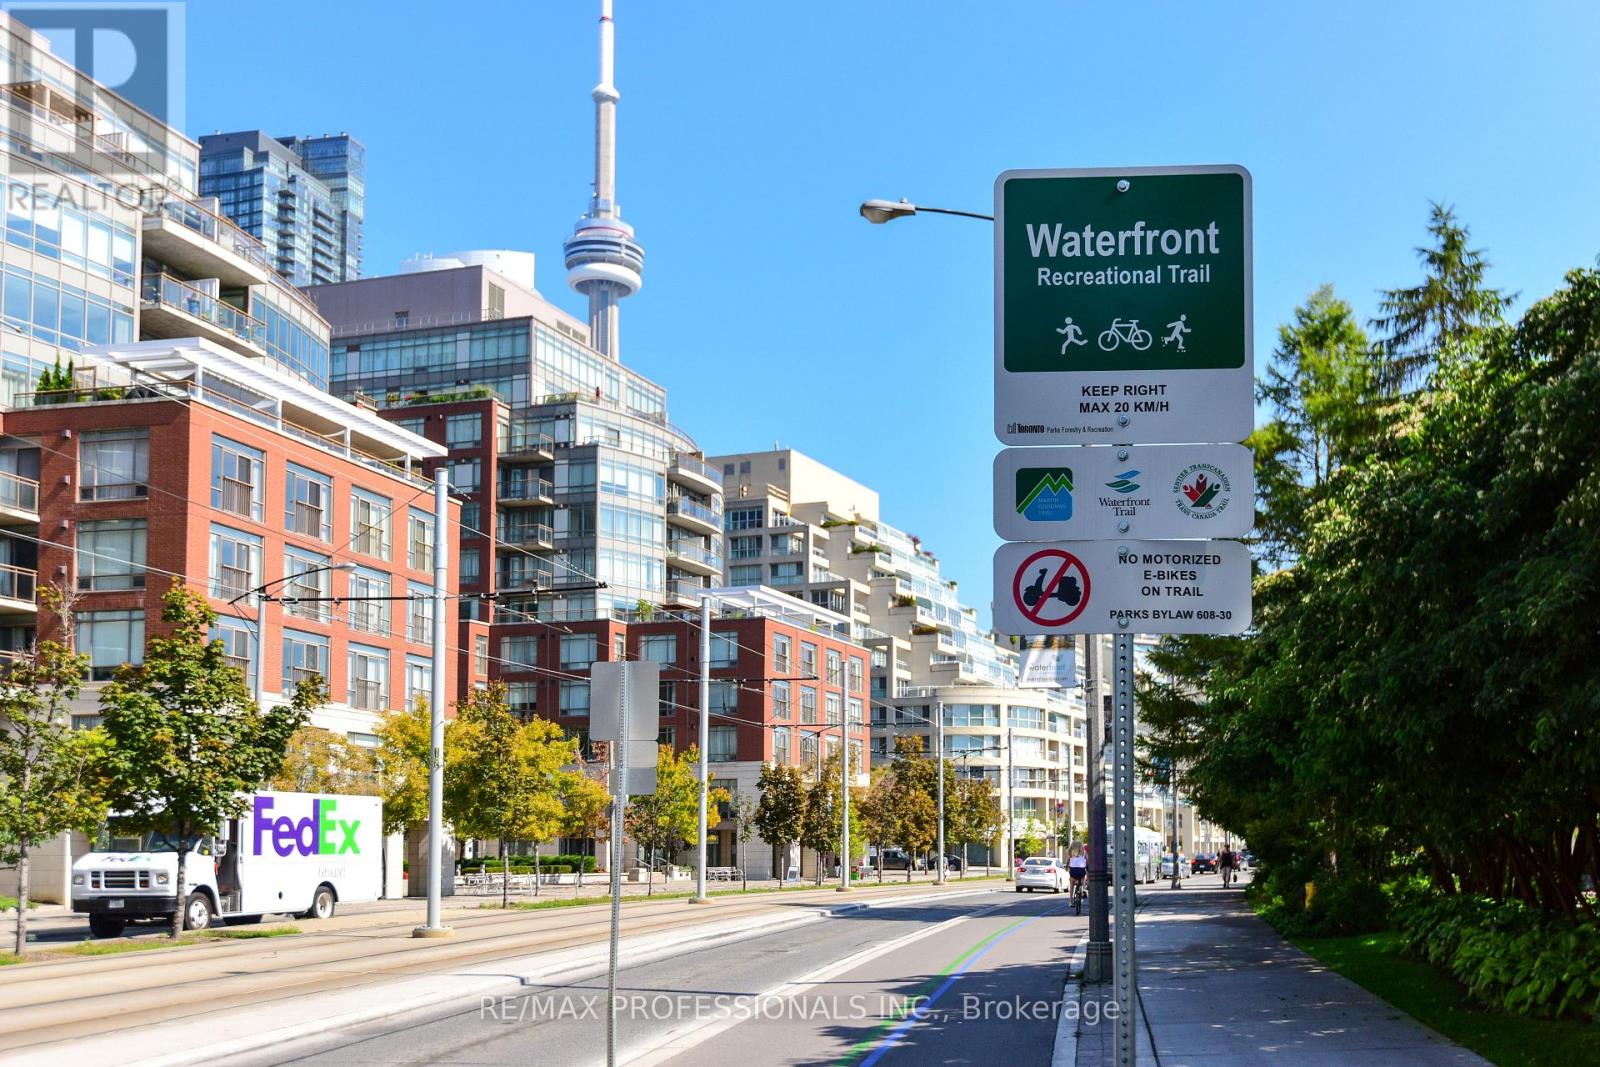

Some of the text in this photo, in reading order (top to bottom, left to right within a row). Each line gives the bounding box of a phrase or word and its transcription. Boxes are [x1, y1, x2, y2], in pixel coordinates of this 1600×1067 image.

[1025, 220, 1220, 257] Waterfront
[1037, 264, 1211, 286] Recreational Trail
[1081, 384, 1167, 397] KEEP RIGHT
[1079, 401, 1169, 413] MAX 20 KM/H
[1099, 497, 1151, 508] Waterfront
[1113, 507, 1137, 517] Trail
[1191, 512, 1218, 520] CANADA
[1118, 555, 1221, 565] NO MOTORIZED
[1144, 571, 1197, 581] E-BIKES
[1141, 587, 1204, 597] ON TRAIL
[1109, 610, 1232, 620] PARKS BYLAW 608-30
[1029, 663, 1066, 672] waterfr
[253, 796, 361, 857] FedEx
